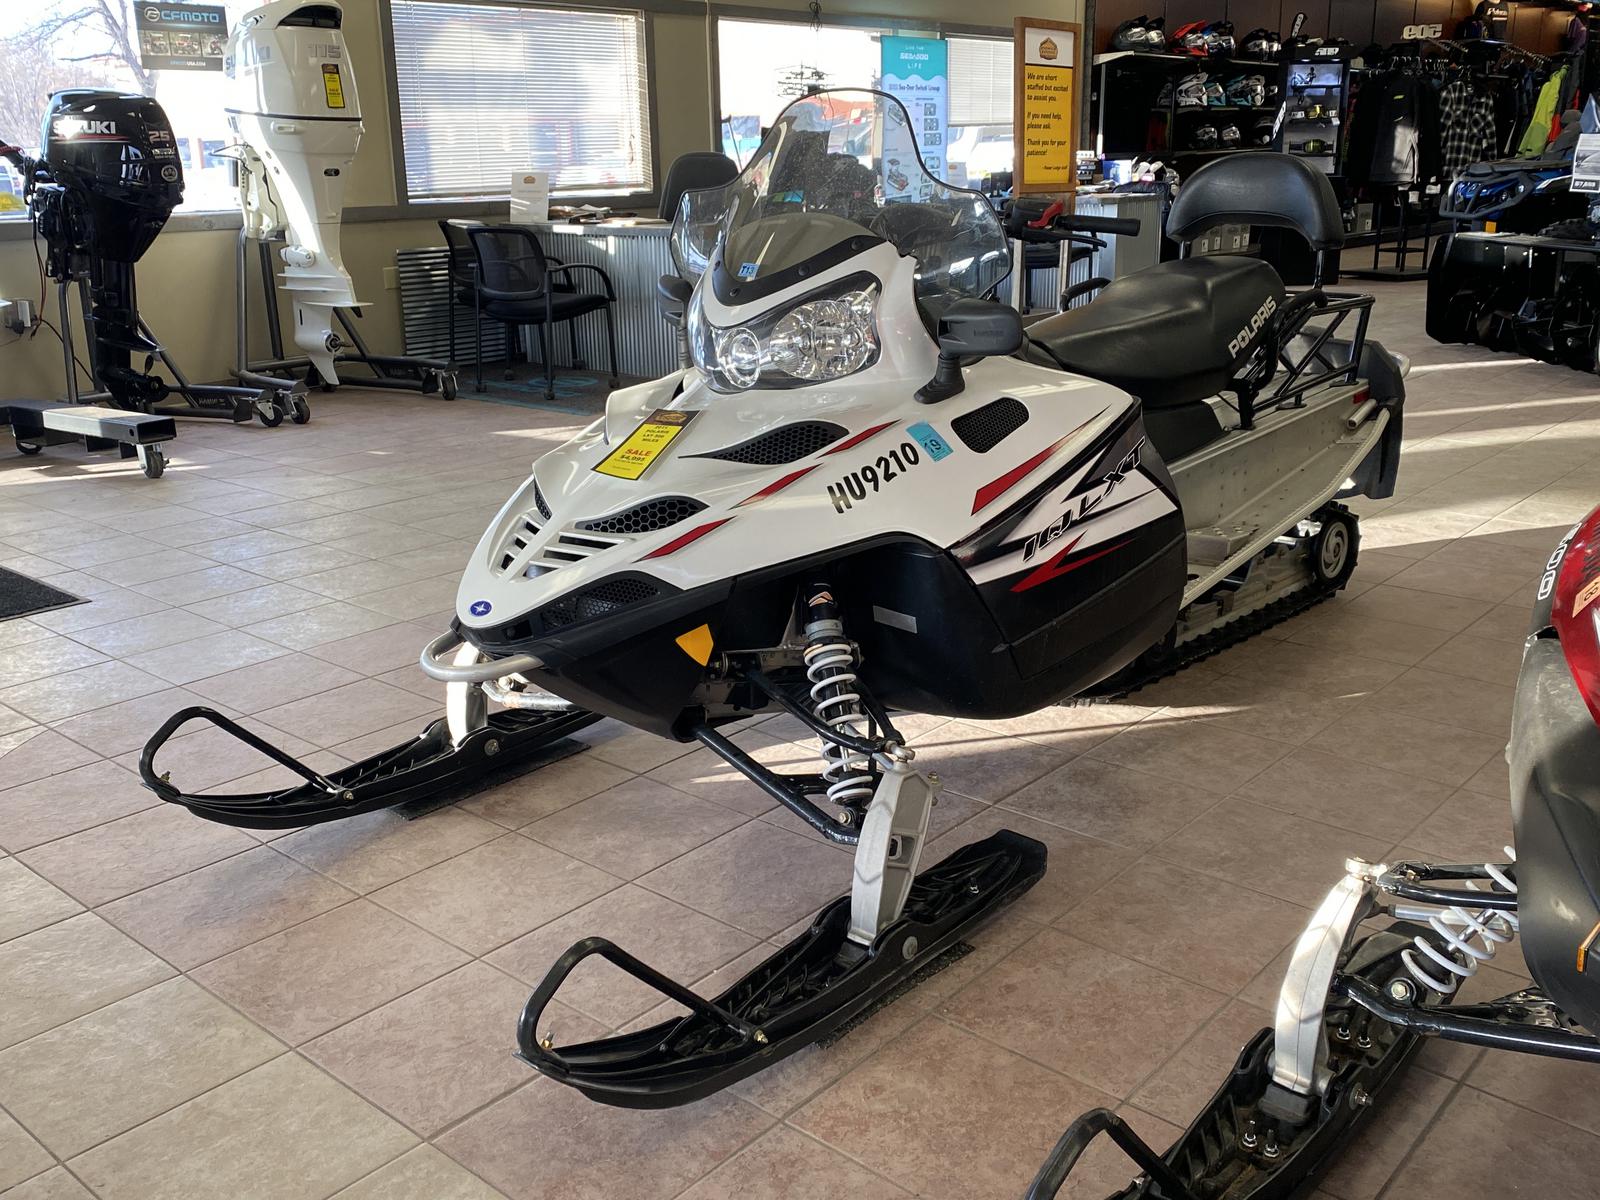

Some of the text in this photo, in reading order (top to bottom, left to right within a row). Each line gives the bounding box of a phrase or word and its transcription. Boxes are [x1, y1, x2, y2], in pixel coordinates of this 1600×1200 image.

[161, 10, 219, 22] CFMOTO
[307, 43, 340, 59] 115
[1027, 72, 1035, 80] We
[1027, 122, 1042, 131] please
[149, 131, 170, 142] 25
[1228, 295, 1277, 359] POLARIS
[624, 448, 653, 457] SALE
[826, 442, 920, 514] HU9210
[1023, 436, 1146, 562] IQ LXT
